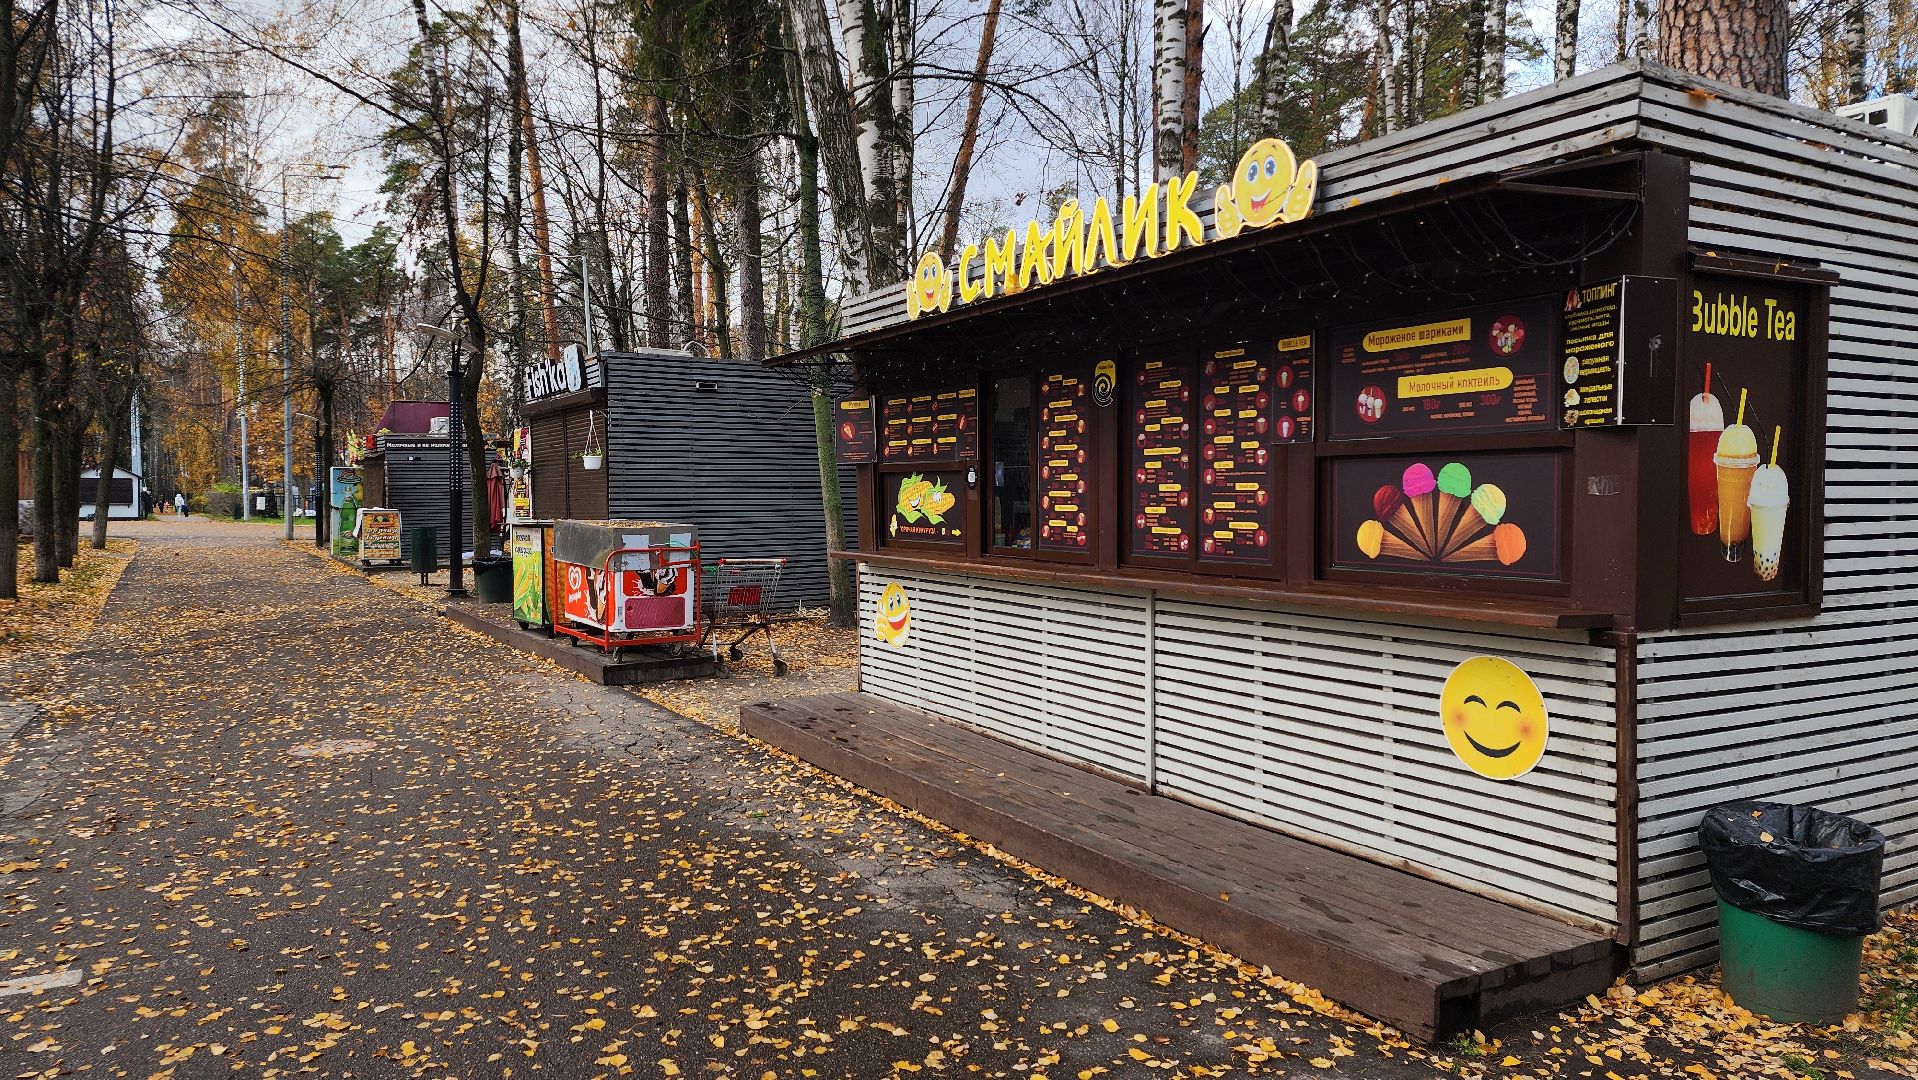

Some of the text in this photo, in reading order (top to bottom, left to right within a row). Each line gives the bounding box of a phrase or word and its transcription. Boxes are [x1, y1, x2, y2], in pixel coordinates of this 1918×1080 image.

[959, 170, 1204, 304] СМАЙЛИК
[1582, 282, 1618, 303] ТОППИНГ
[1692, 289, 1796, 341] Bubble Tea
[1368, 324, 1464, 349] Мороженое шариками
[1597, 331, 1614, 341] для
[1565, 341, 1615, 354] мороженого
[1408, 373, 1500, 393] Молочный коктейль
